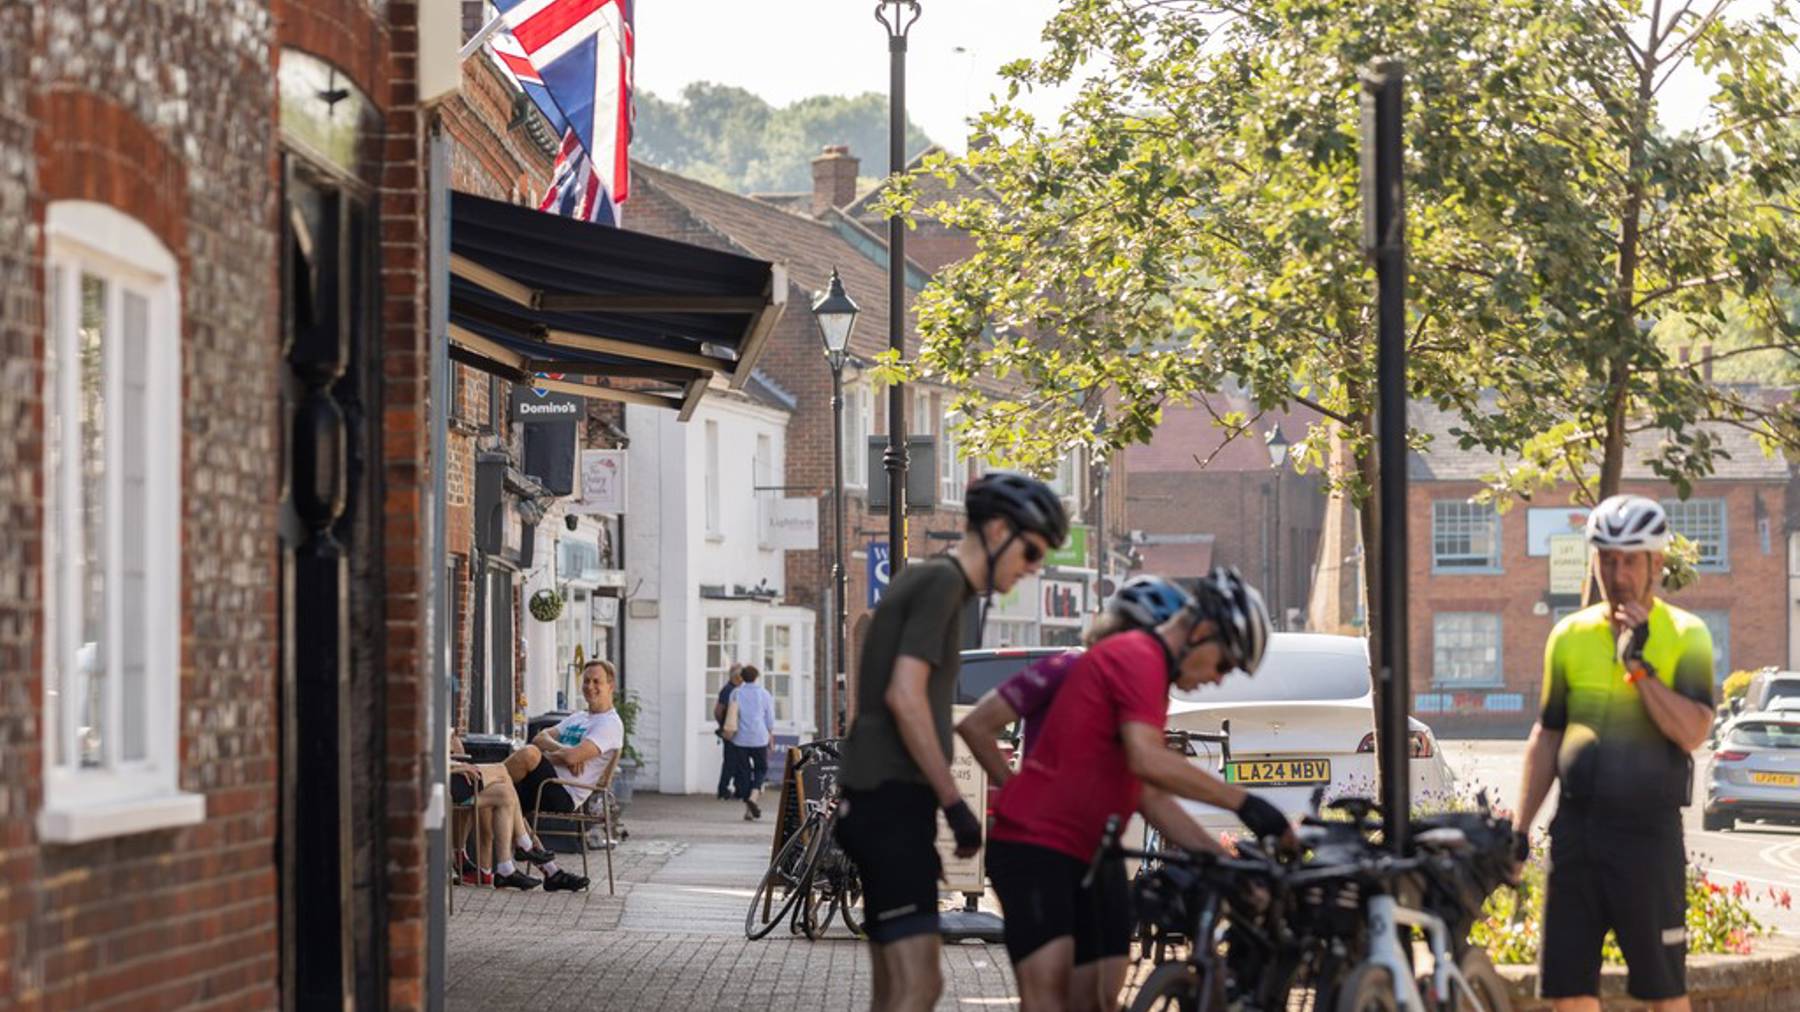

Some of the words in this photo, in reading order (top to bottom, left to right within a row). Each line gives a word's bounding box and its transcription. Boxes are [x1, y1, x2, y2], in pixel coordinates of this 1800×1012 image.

[520, 402, 577, 414] Domino's
[1237, 763, 1286, 781] LA24
[1290, 761, 1326, 779] MBV
